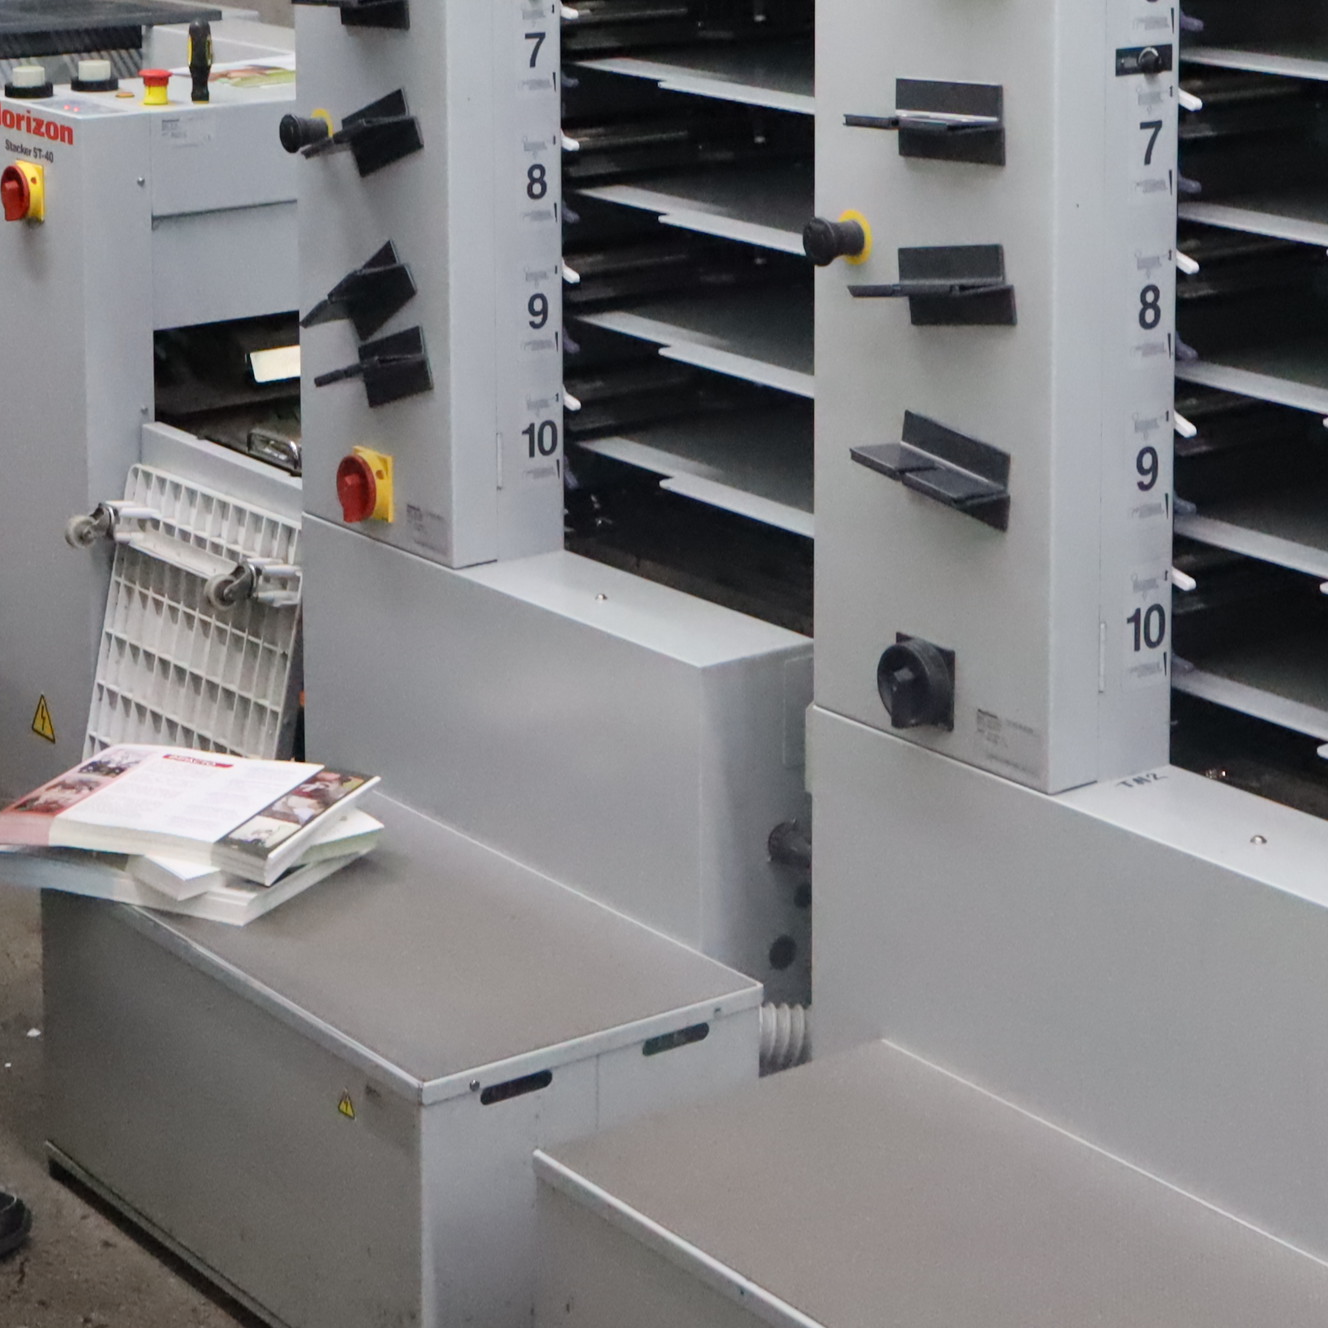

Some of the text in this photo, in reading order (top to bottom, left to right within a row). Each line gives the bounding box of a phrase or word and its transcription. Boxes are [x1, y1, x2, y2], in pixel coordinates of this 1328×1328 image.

[524, 31, 546, 68] 7
[5, 138, 32, 157] Stacker
[1139, 119, 1163, 166] 7
[526, 163, 548, 200] 8
[527, 293, 549, 330] 9
[1138, 284, 1162, 330] 8
[521, 419, 558, 459] 10
[1136, 446, 1159, 492] 9
[1126, 603, 1166, 653] 10
